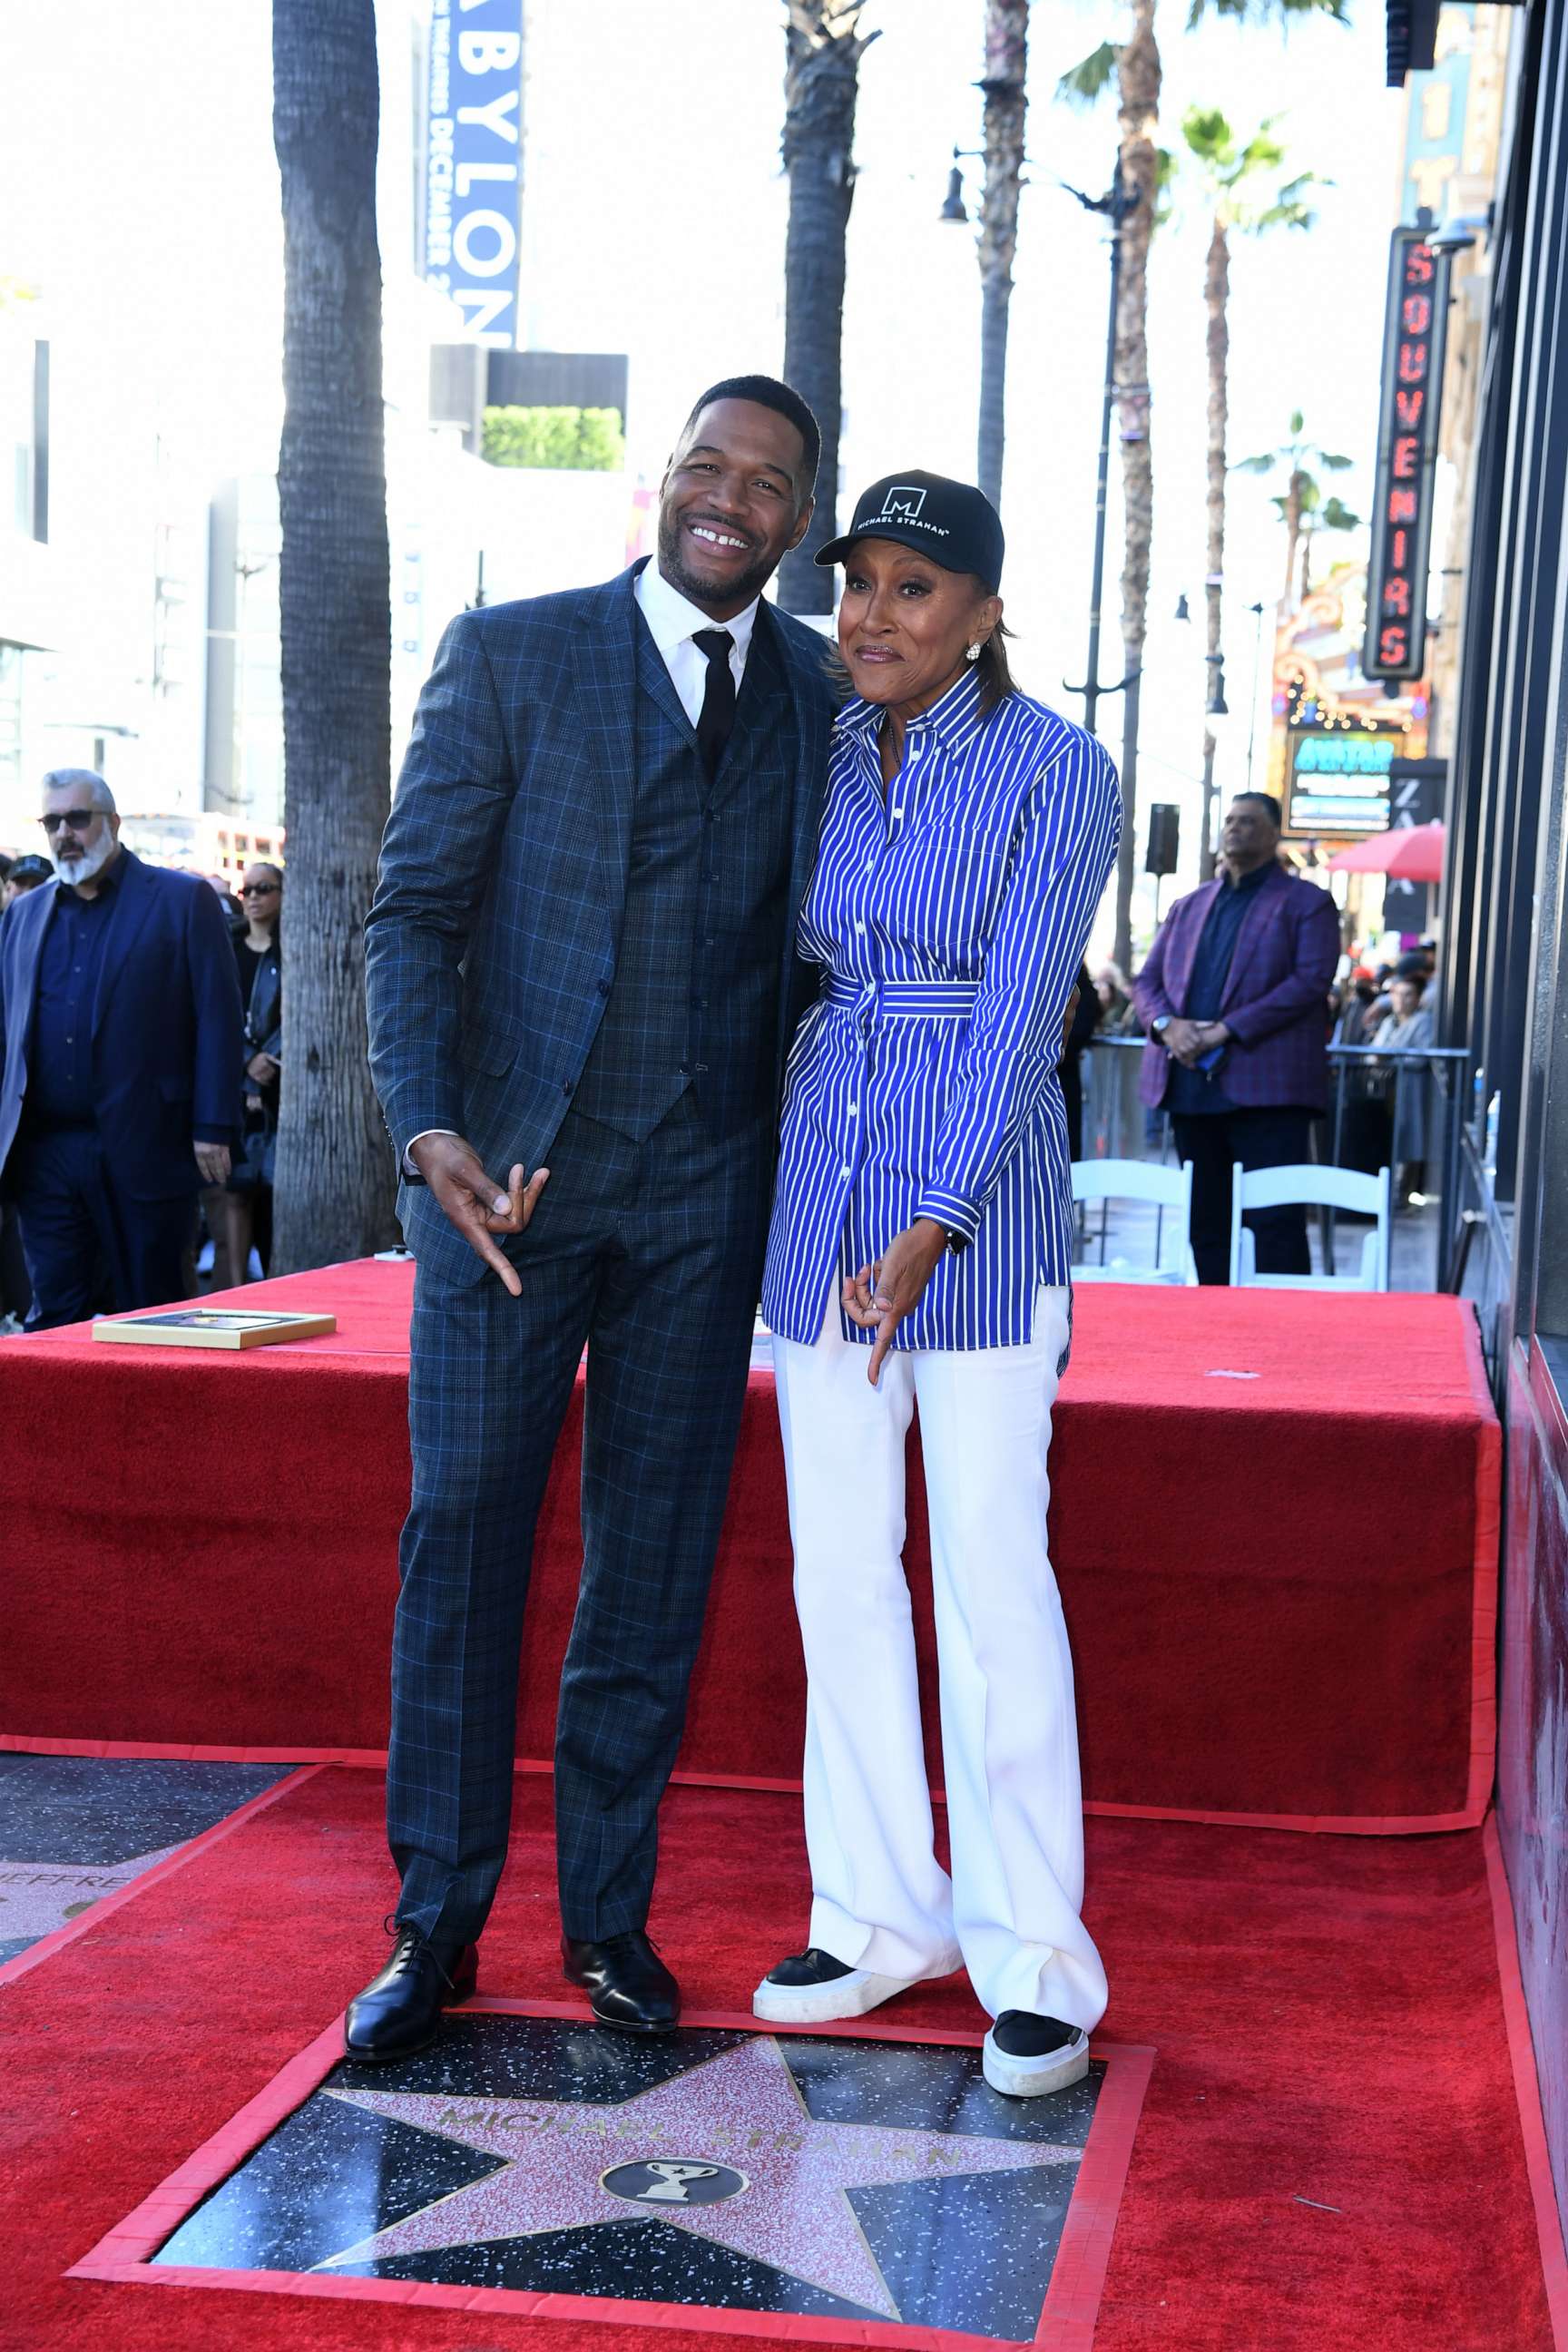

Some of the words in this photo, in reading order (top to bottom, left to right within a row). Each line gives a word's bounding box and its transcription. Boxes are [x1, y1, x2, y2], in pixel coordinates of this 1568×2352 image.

[427, 118, 454, 266] DECEMBER
[426, 272, 452, 299] 2
[1379, 242, 1435, 666] SOUVENIRS
[858, 515, 893, 530] MICHAEL
[438, 2108, 674, 2141] MICHAEL
[710, 2126, 962, 2166] STRAHAN
